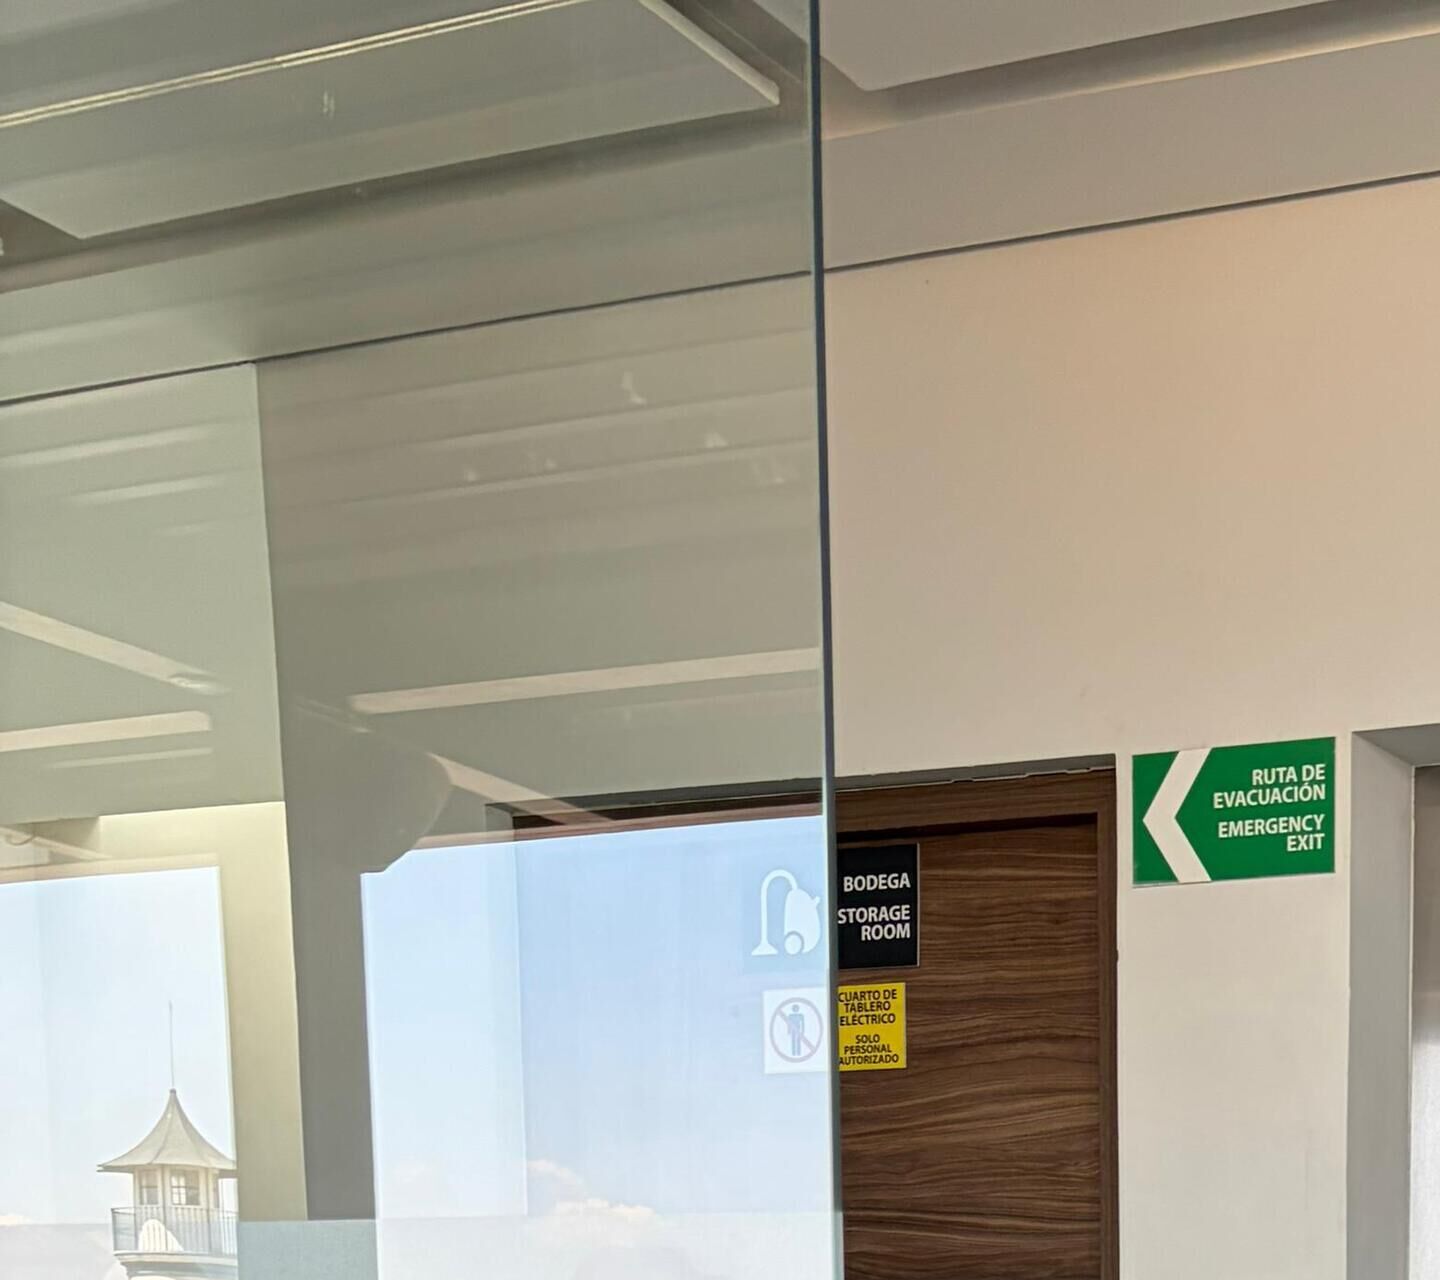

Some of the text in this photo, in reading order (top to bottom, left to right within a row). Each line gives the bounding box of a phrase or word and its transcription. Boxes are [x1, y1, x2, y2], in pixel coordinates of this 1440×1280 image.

[1252, 763, 1326, 786] RUTA DE
[1213, 782, 1326, 809] EVACUACIÓN
[1218, 814, 1325, 838] EMERGENCY
[1286, 833, 1325, 852] EXIT
[843, 872, 911, 893] BODEGA
[837, 904, 911, 925] STORAGE
[861, 922, 911, 941] ROOM
[838, 989, 897, 1002] CUARTO DE
[844, 1001, 891, 1013] TABLERO
[855, 1034, 880, 1044] SOLO
[844, 1044, 892, 1055] PERSONAL
[839, 1054, 899, 1066] AUTORIZADO
